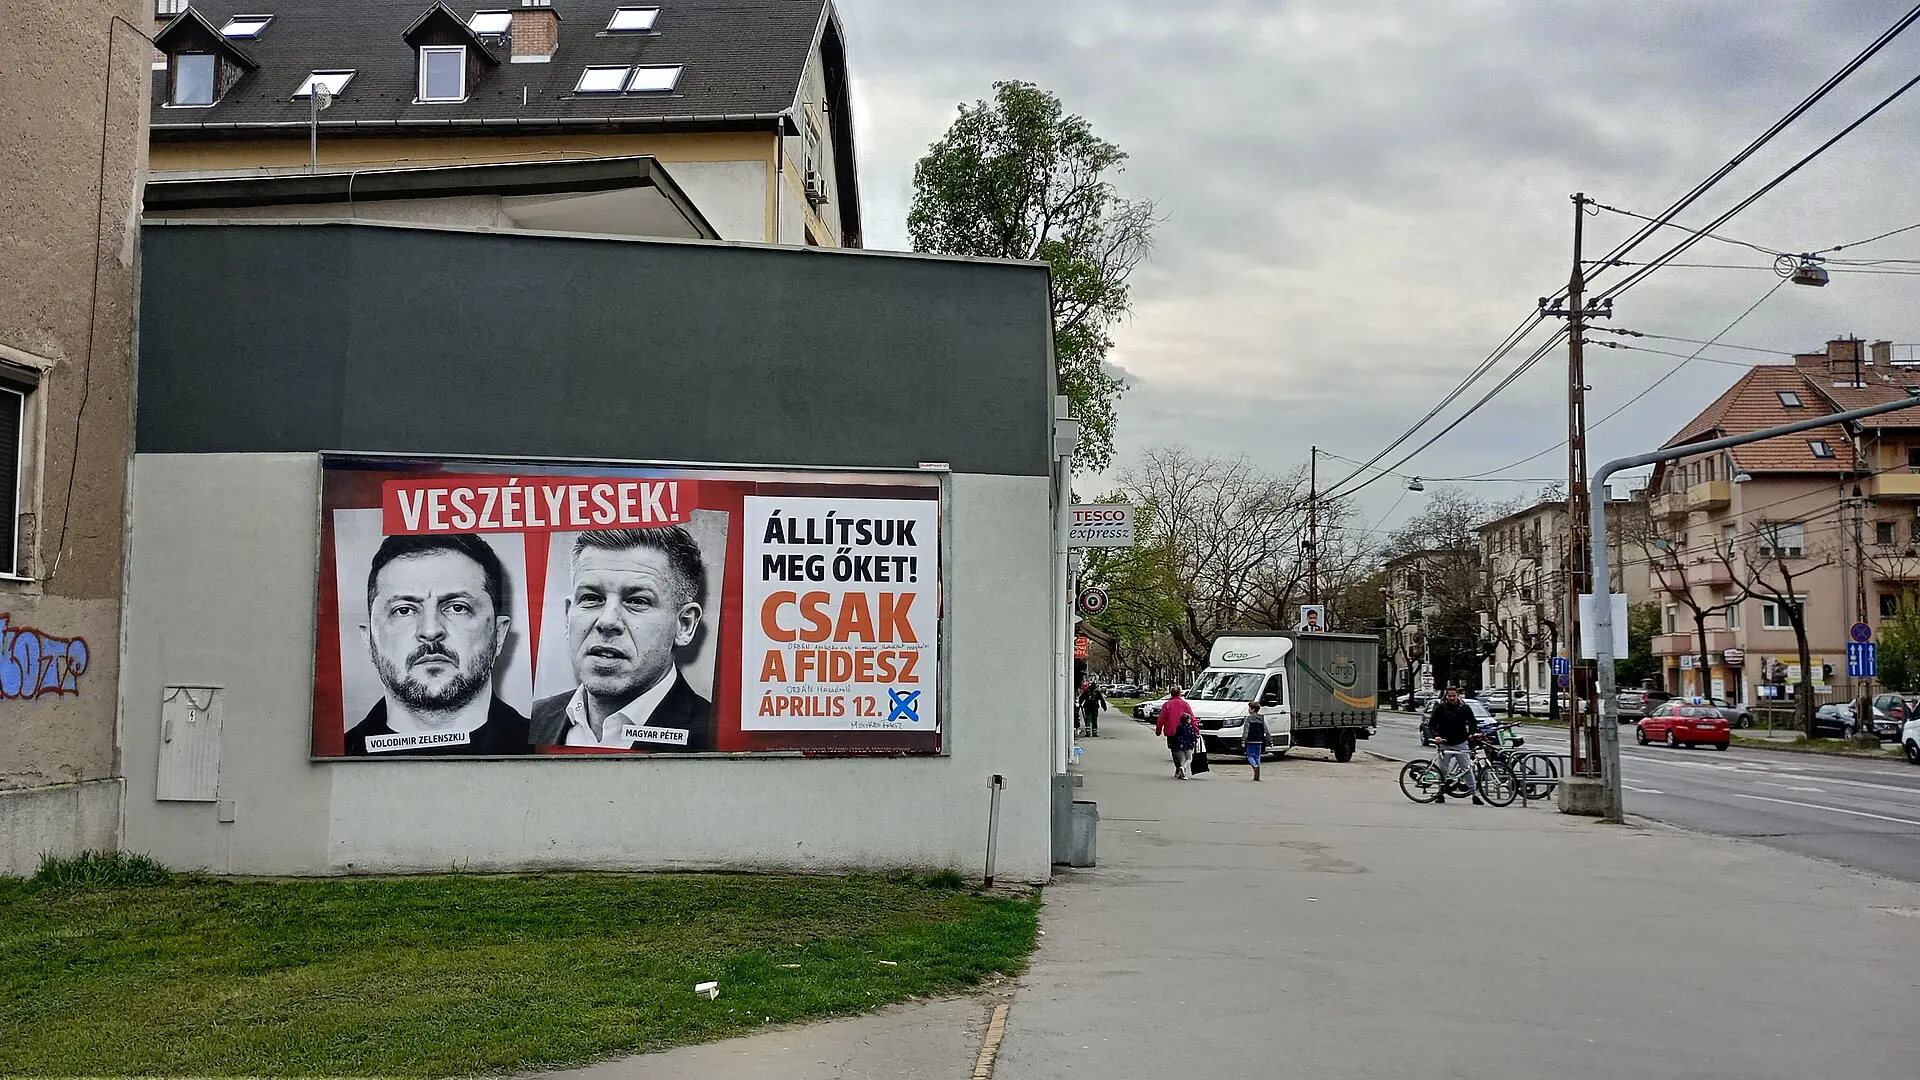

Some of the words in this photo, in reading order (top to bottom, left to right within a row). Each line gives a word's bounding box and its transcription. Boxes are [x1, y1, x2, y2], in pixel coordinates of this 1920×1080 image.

[396, 477, 680, 532] VESZÉLYESEK!
[1073, 510, 1126, 521] TESCO
[763, 509, 917, 546] ÁLLÍTSUK
[1069, 528, 1130, 542] expressz
[762, 554, 825, 582] MEG
[832, 547, 918, 583] ŐKET!
[760, 590, 918, 643] CSAK
[759, 650, 787, 682] A
[794, 650, 919, 683] FIDESZ
[1222, 650, 1258, 662] Cargo
[758, 690, 845, 717] ÁPRILIS
[852, 696, 883, 717] 12.
[370, 736, 417, 748] VOLODIMIR
[418, 732, 466, 744] ZELENSZKIJ
[625, 729, 658, 739] MAGYAR
[659, 730, 684, 741] PÉTER
